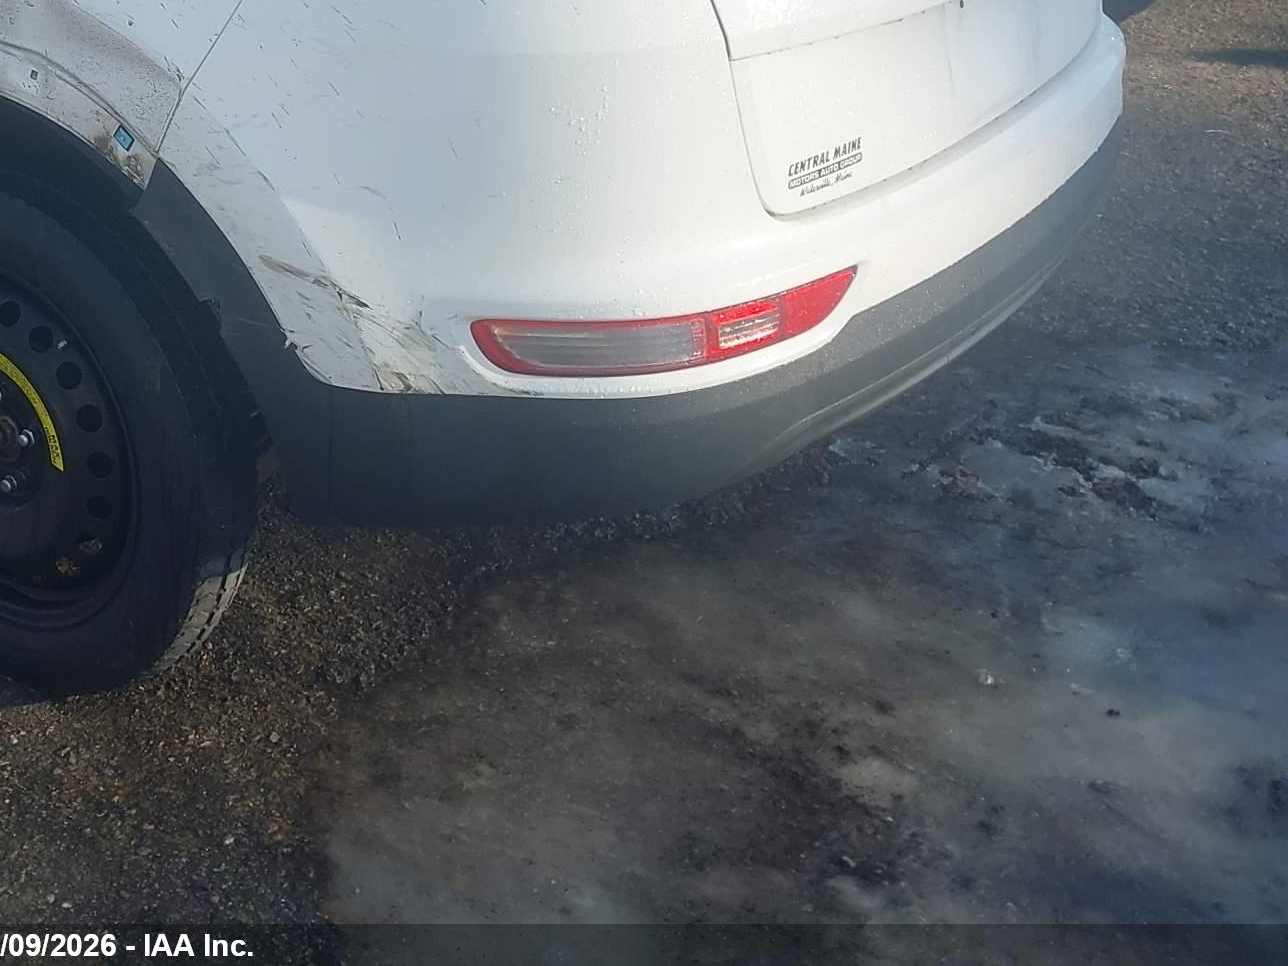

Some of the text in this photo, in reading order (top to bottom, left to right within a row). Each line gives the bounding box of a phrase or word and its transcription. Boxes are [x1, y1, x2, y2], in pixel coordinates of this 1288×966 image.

[788, 137, 862, 177] CENTRAL MAINE
[790, 171, 819, 187] MOTORS
[820, 164, 839, 177] AUTO
